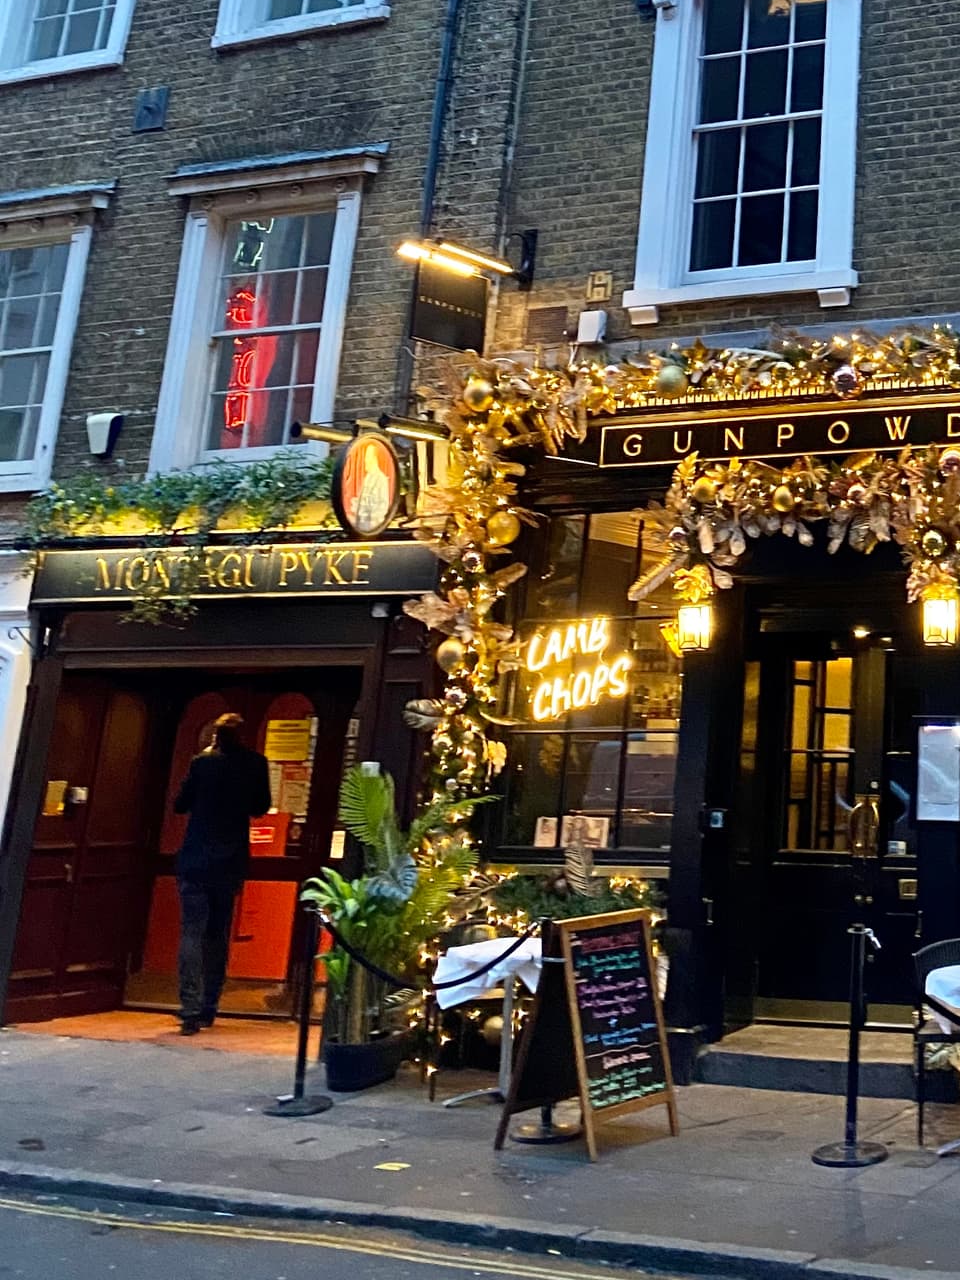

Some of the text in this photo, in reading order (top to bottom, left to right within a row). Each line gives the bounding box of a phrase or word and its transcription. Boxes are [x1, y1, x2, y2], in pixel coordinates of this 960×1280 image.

[94, 549, 373, 591] MONAGU PYKE
[527, 615, 609, 673] LAMB
